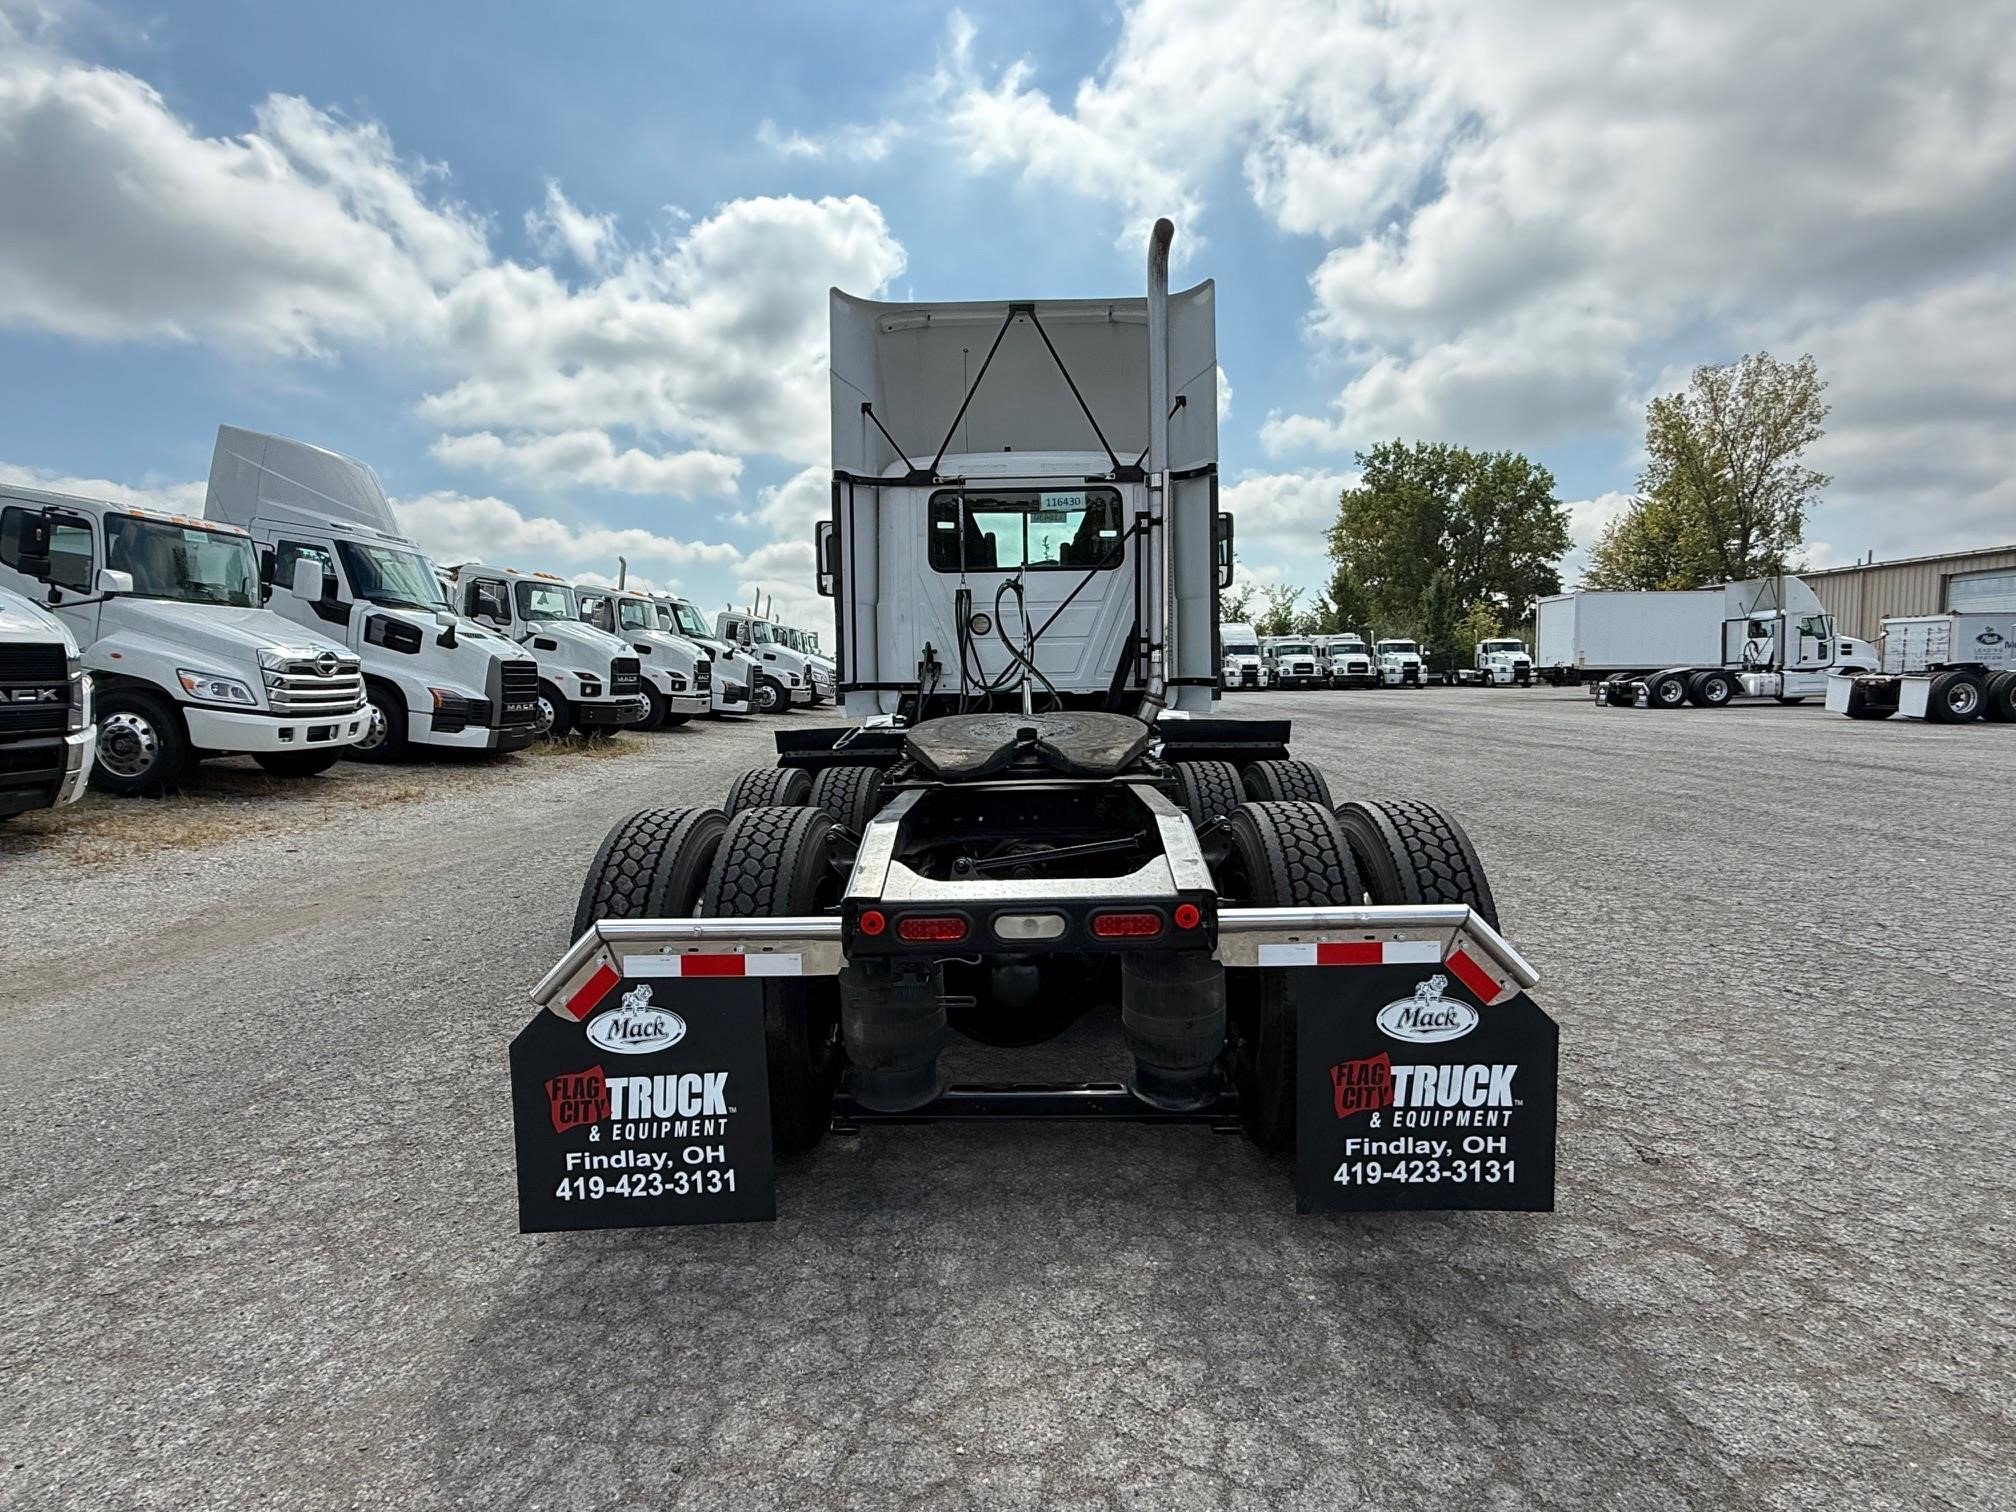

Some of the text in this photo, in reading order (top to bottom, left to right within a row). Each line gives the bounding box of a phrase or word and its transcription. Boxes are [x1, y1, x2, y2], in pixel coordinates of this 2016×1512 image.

[1046, 497, 1081, 507] 116430
[507, 703, 537, 711] MACK
[605, 1015, 670, 1042] Mack
[1394, 1005, 1460, 1030] Mack
[1336, 1062, 1385, 1087] FLAG
[1390, 1063, 1518, 1108] TRUCK
[551, 1076, 601, 1100] FLAG
[605, 1072, 729, 1120] TRUCK
[1342, 1084, 1391, 1110] CITY
[558, 1098, 609, 1124] CITY
[1369, 1110, 1513, 1129] & EQUIPMENT
[588, 1118, 728, 1142] & EQUIPMENT
[565, 1145, 726, 1171] Findlay, OH
[1345, 1136, 1507, 1158] Findlay, OH
[555, 1168, 736, 1201] 419-423-3131
[1333, 1159, 1516, 1186] 419-423-3131
